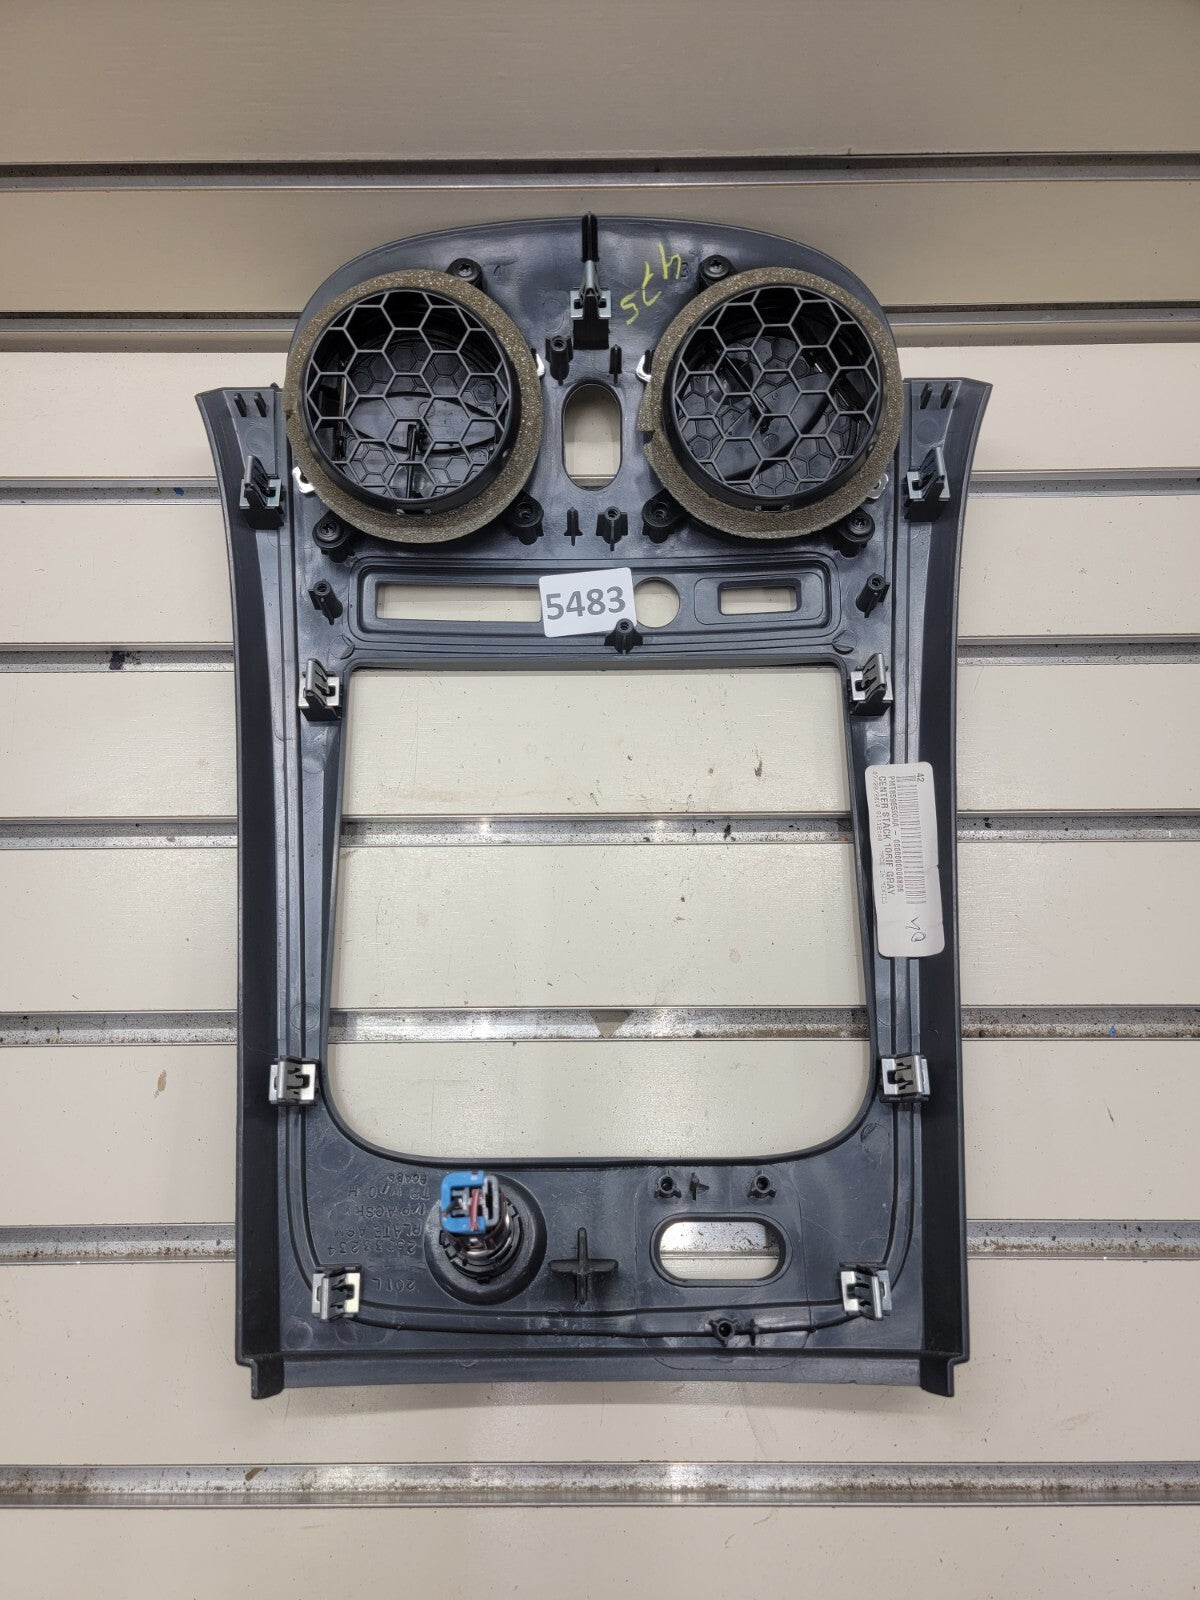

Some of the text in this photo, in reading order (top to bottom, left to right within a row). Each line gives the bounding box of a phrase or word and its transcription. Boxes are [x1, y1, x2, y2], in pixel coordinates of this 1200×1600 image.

[546, 586, 626, 620] 5483
[878, 775, 889, 809] CENTER
[916, 773, 925, 782] 42
[881, 811, 892, 840] STACK
[886, 871, 896, 895] GRAY
